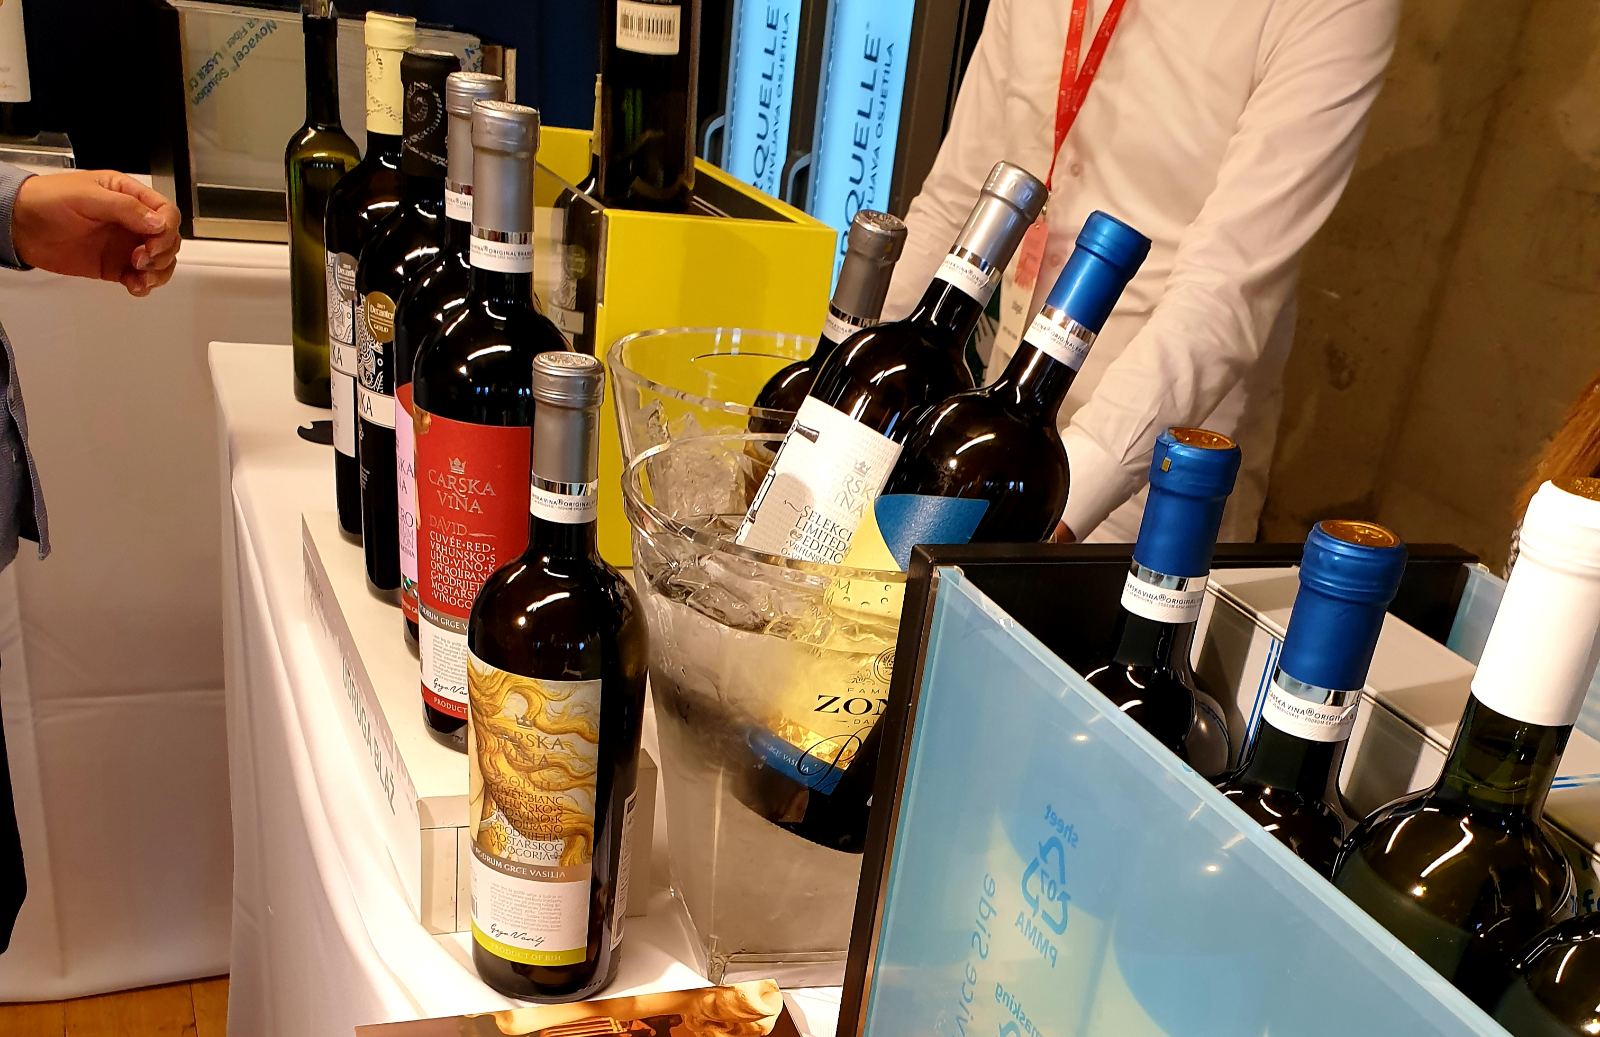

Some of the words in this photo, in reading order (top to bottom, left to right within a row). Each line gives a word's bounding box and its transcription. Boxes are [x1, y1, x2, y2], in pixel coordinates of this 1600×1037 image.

[874, 42, 895, 139] OSJETILA
[428, 468, 497, 498] CARSKA
[436, 489, 484, 515] VINA
[429, 513, 468, 537] DAVID
[795, 515, 847, 552] LIMITED
[433, 696, 468, 715] PRODUCT
